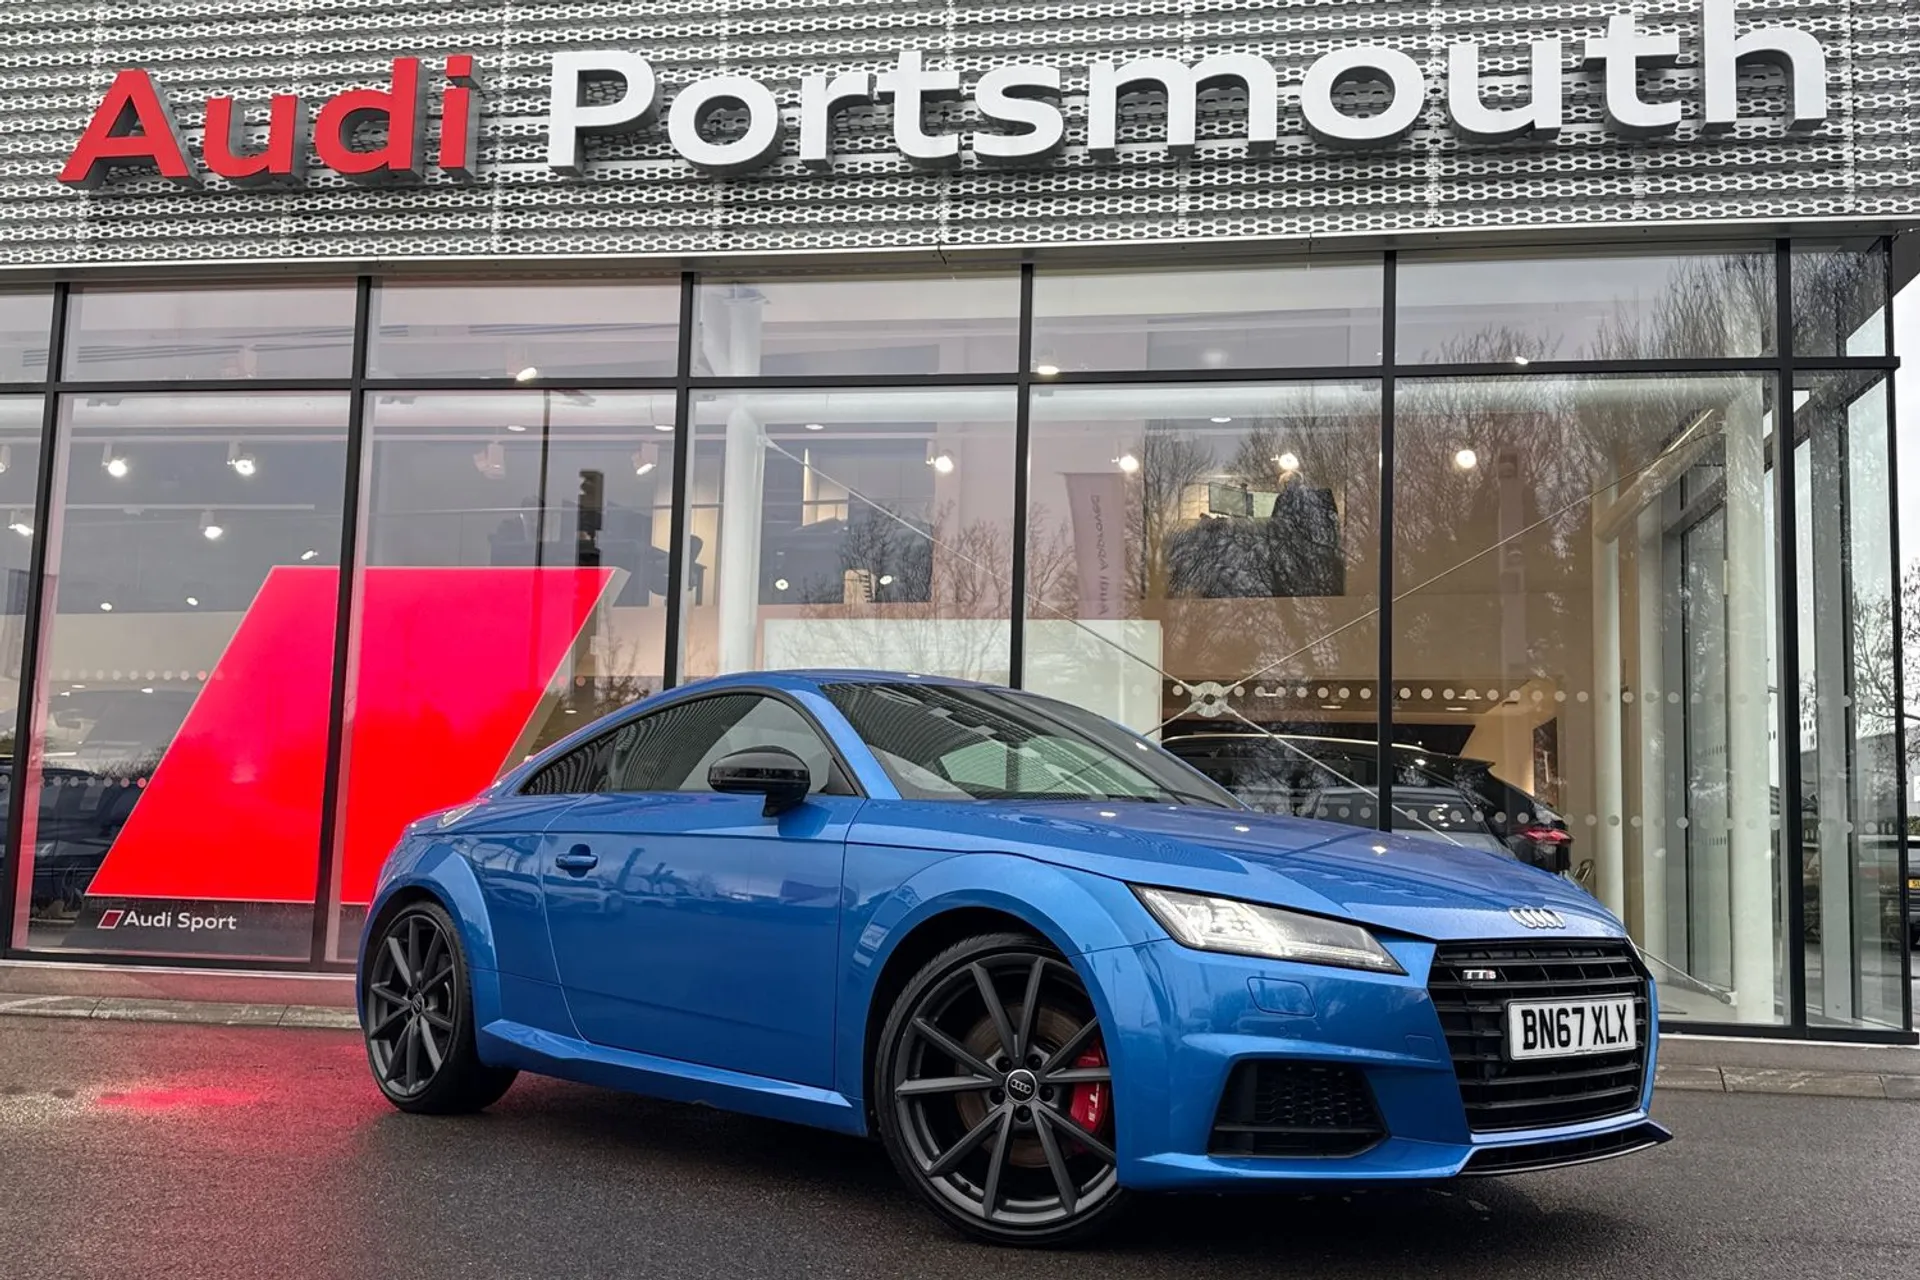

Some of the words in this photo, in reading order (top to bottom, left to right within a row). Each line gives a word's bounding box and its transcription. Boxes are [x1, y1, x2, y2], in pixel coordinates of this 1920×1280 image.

[57, 55, 474, 183] Audi
[547, 0, 1828, 168] Portsmouth
[124, 911, 172, 927] Audi
[177, 912, 237, 932] Sport
[1521, 1006, 1585, 1050] BN67
[1592, 1003, 1629, 1046] XLX
